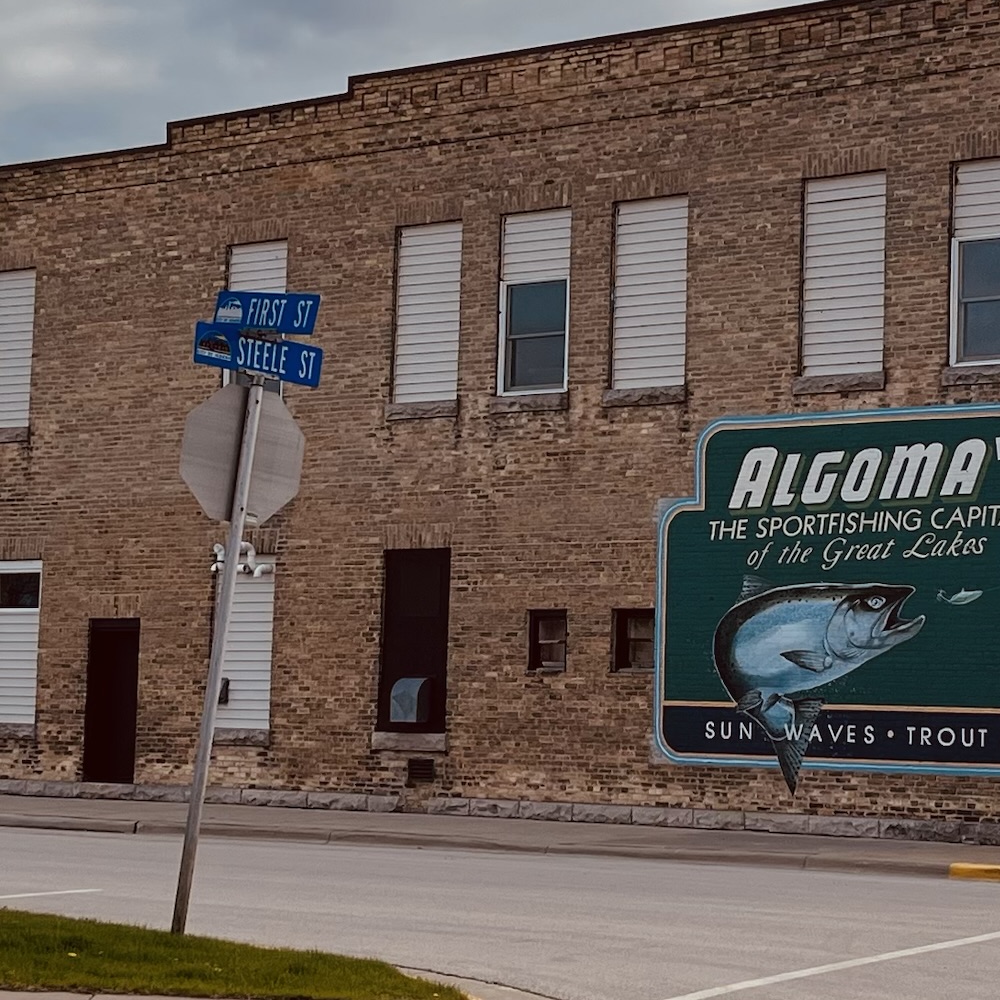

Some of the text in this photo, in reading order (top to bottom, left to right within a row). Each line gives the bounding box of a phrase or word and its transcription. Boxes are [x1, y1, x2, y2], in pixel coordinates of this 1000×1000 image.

[246, 298, 314, 328] FIRST ST
[236, 336, 316, 380] STEELE ST
[728, 438, 988, 511] ALGOMA
[708, 518, 749, 541] THE
[755, 508, 923, 539] SPORTFISHING
[746, 530, 989, 572] of the Great Lakes
[704, 720, 753, 740] SUN
[784, 723, 876, 745] WAVES
[906, 726, 989, 748] TROUT
